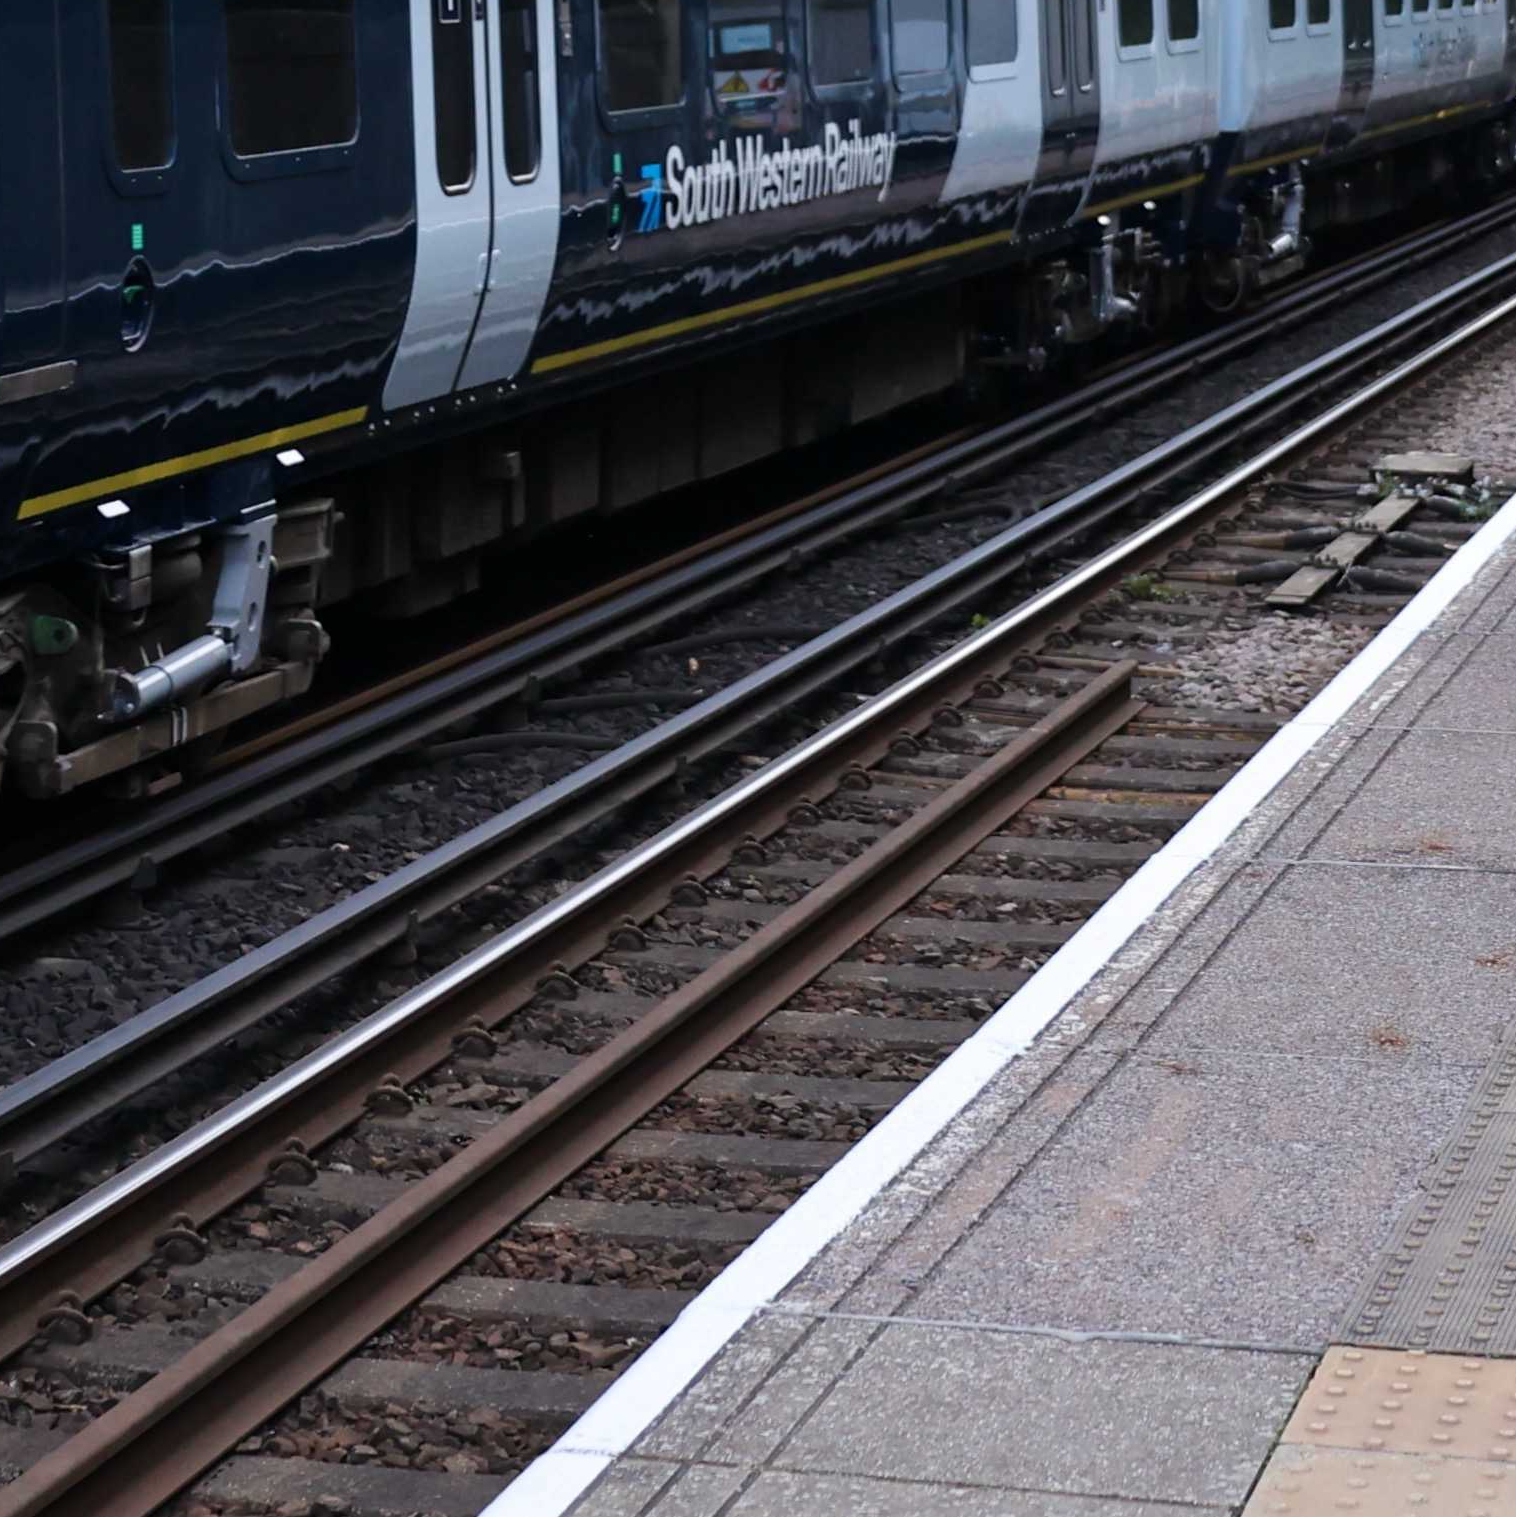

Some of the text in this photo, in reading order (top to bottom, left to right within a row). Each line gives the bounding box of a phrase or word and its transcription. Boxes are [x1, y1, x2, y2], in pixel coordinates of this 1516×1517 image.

[665, 118, 897, 230] South Western Railway
